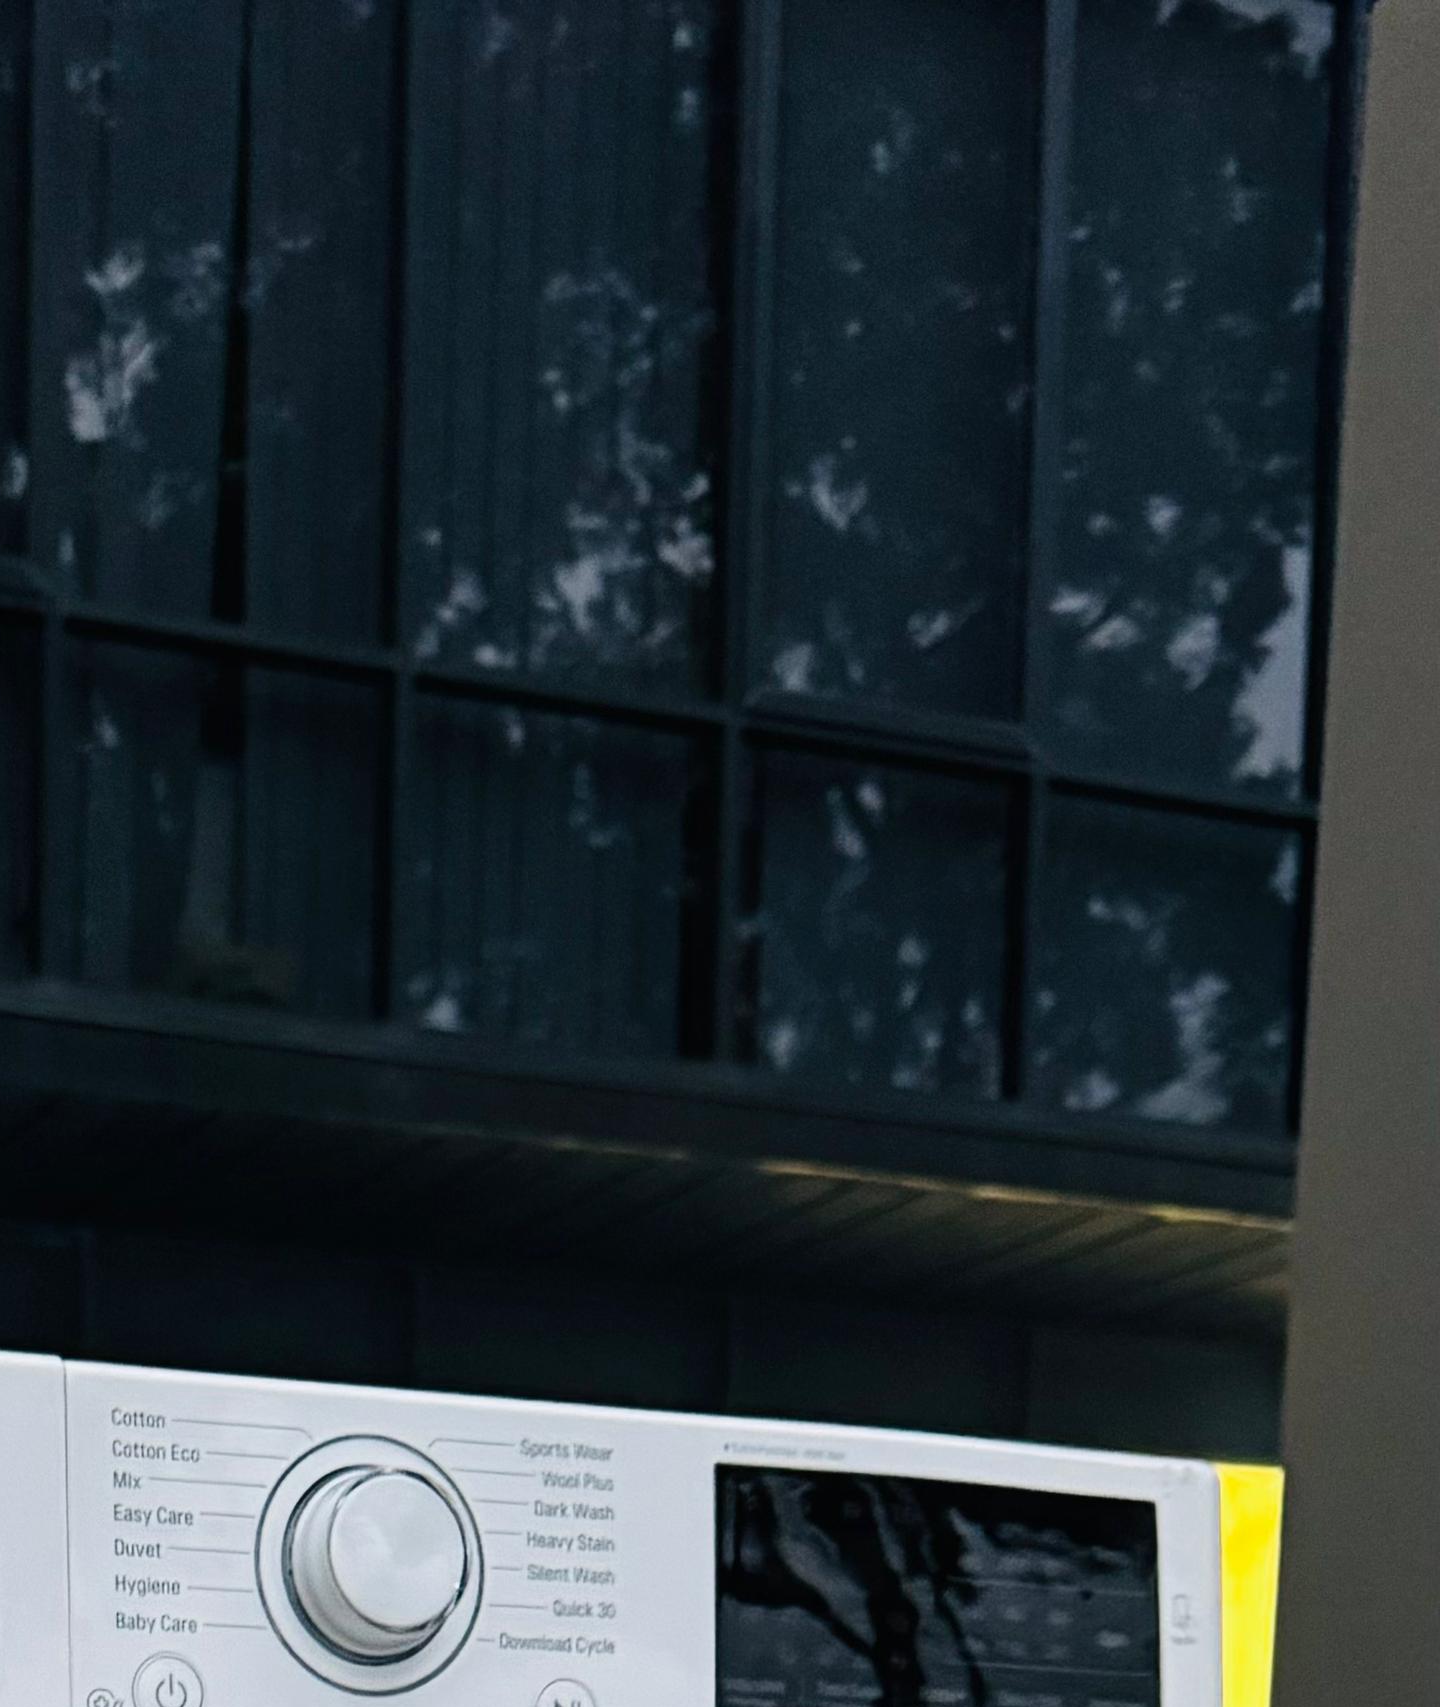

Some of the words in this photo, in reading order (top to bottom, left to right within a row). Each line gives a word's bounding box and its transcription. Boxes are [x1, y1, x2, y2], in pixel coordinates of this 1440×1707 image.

[111, 1407, 166, 1428] Cotton
[112, 1439, 167, 1460] Cotton
[171, 1444, 200, 1463] Eco
[520, 1438, 570, 1458] Sports
[573, 1443, 614, 1461] Wear
[113, 1471, 142, 1489] Mix
[113, 1503, 152, 1527] Easy
[157, 1506, 194, 1526] Care
[534, 1499, 569, 1518] Dark
[573, 1502, 615, 1520] Wash
[114, 1538, 162, 1559] Duvet
[526, 1531, 574, 1552] Heavy
[577, 1533, 615, 1552] Stain
[526, 1563, 569, 1582] Silent
[573, 1567, 615, 1584] Wash
[115, 1574, 181, 1597] Hygiene
[553, 1600, 593, 1617] Quick
[597, 1601, 616, 1619] 30
[115, 1612, 156, 1634] Baby
[161, 1614, 198, 1633] Care
[499, 1632, 573, 1652] Download
[575, 1636, 615, 1658] Cycle
